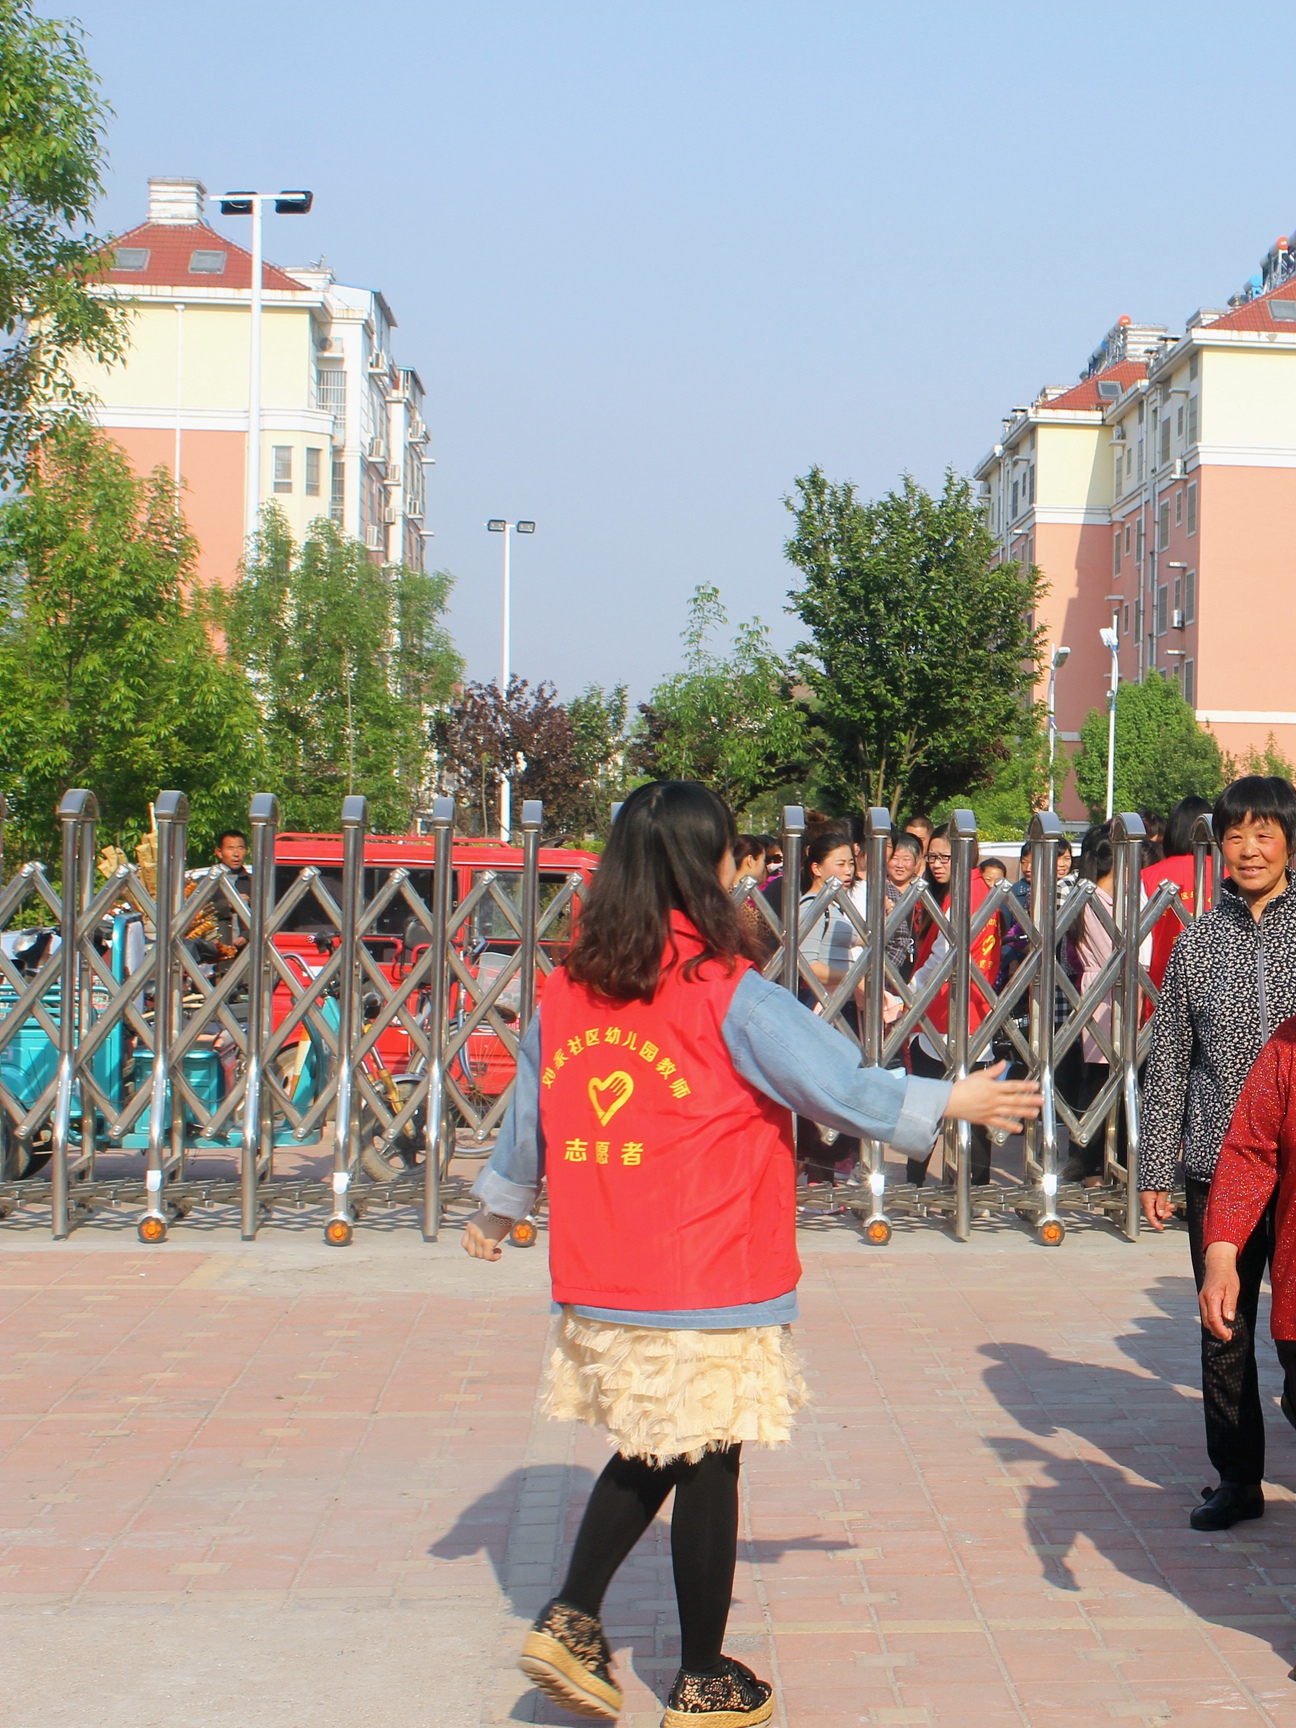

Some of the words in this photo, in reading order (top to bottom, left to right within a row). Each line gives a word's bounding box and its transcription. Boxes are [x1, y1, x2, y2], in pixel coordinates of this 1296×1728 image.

[542, 1027, 691, 1099] 刘家社区幼儿园教师
[563, 1138, 644, 1166] 志愿者
